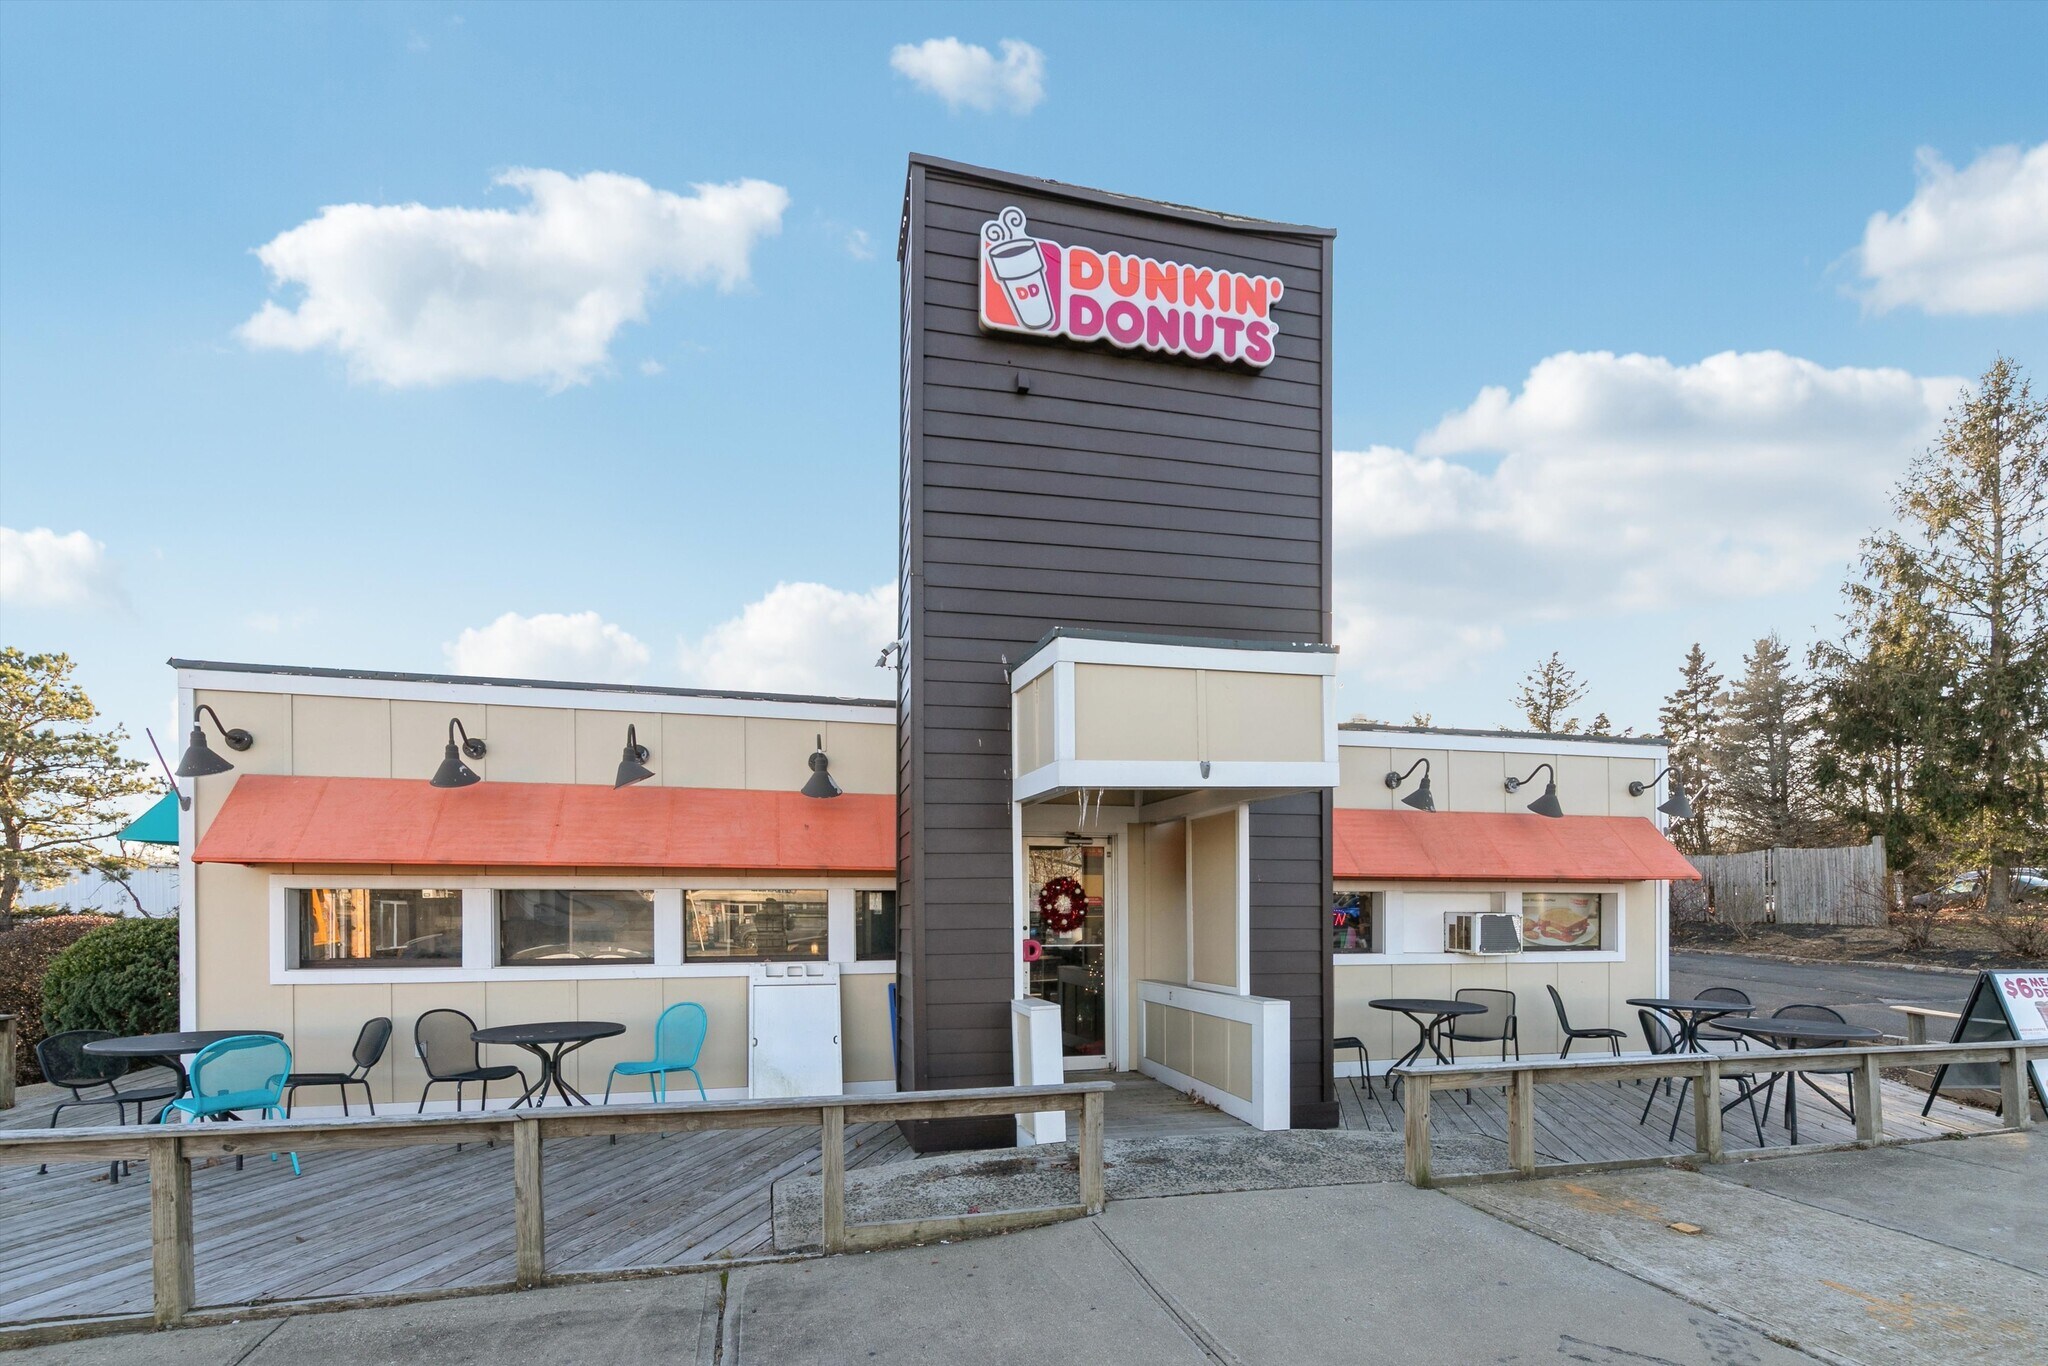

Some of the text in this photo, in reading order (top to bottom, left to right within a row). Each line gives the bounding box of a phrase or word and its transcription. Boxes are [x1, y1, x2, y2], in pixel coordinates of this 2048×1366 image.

[1015, 283, 1040, 300] DD
[1069, 248, 1281, 318] DUNKIN'
[1069, 294, 1272, 363] DONUTS
[2004, 977, 2048, 999] $6 ME
